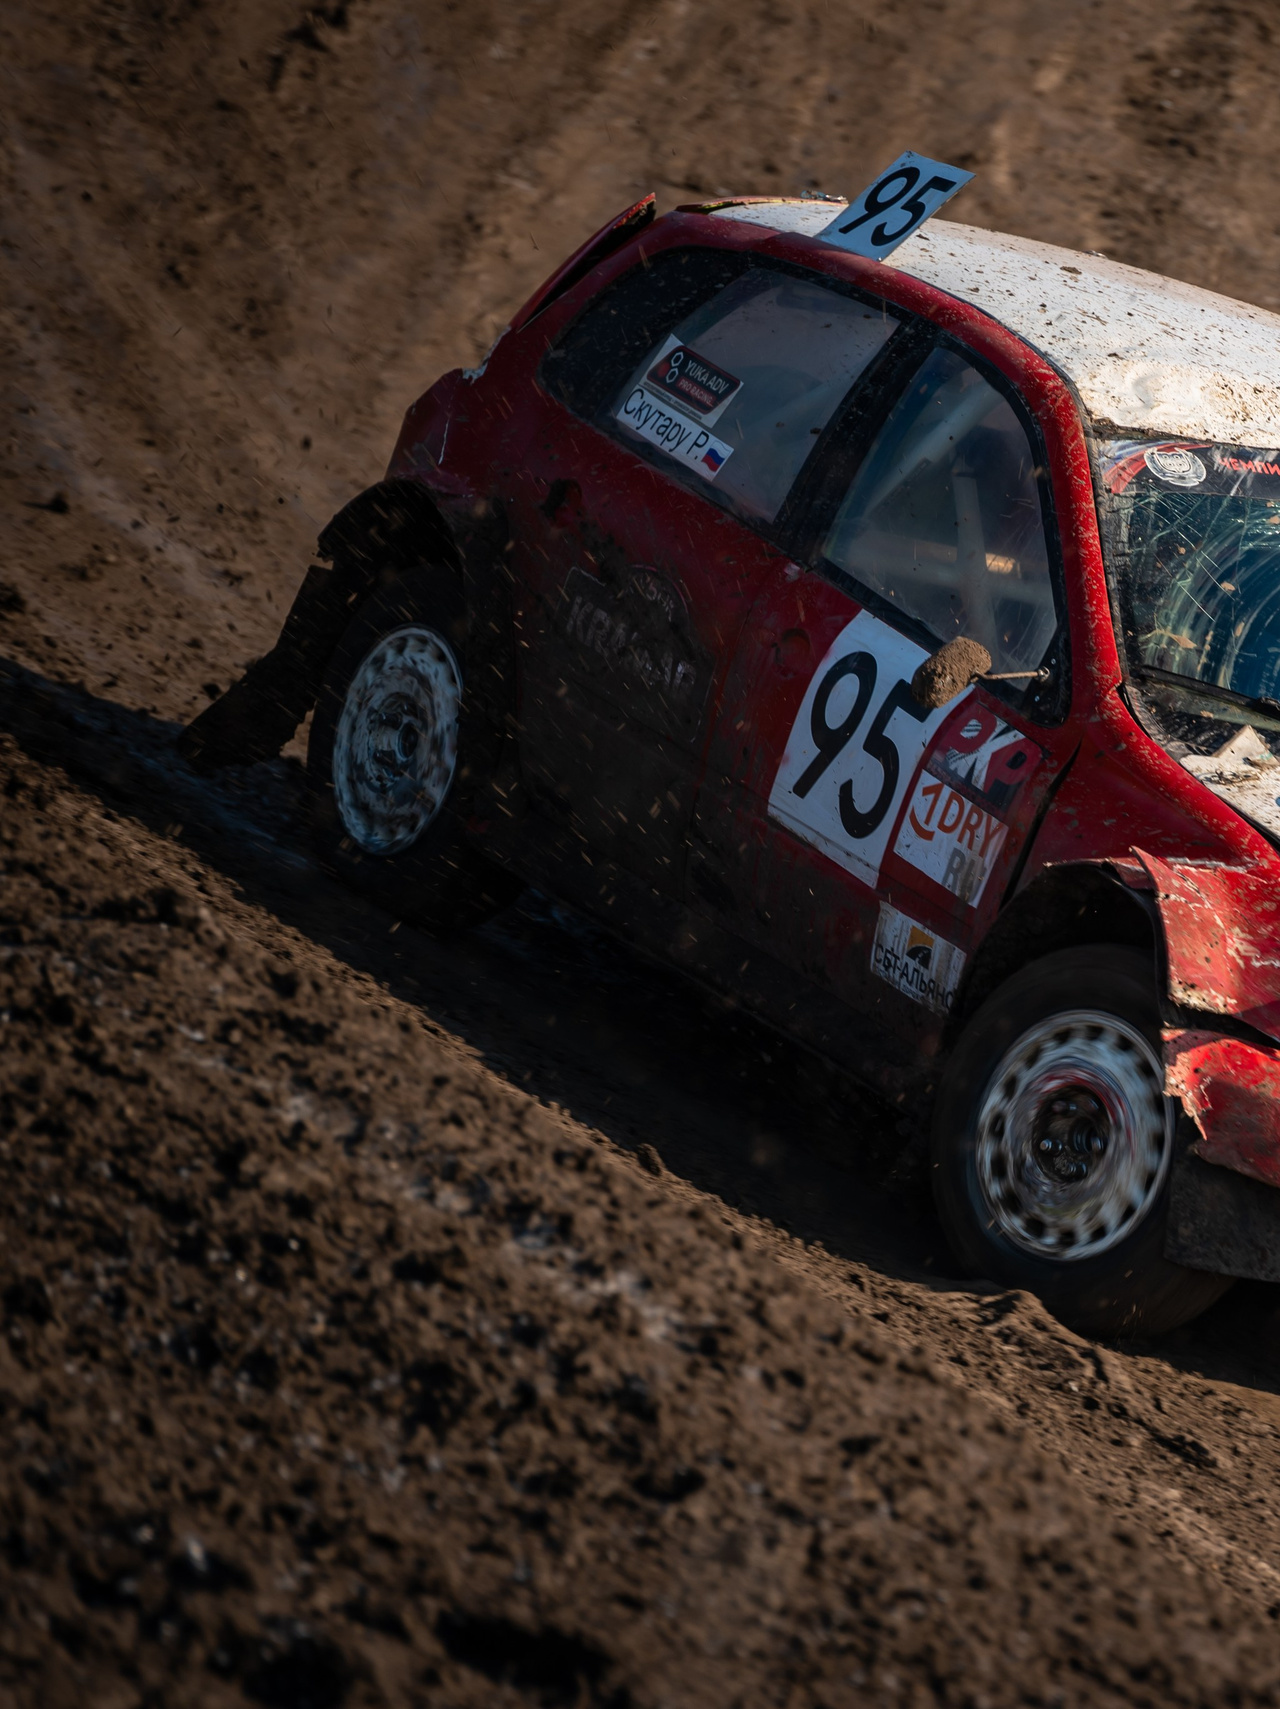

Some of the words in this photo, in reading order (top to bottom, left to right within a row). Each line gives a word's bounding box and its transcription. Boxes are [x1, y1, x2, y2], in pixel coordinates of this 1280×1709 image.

[838, 167, 957, 246] 95
[678, 379, 692, 392] PRO
[690, 386, 714, 406] RACING
[684, 360, 709, 384] YUKA
[706, 375, 730, 394] ADV
[624, 388, 692, 452] Скутару
[792, 651, 935, 839] 95
